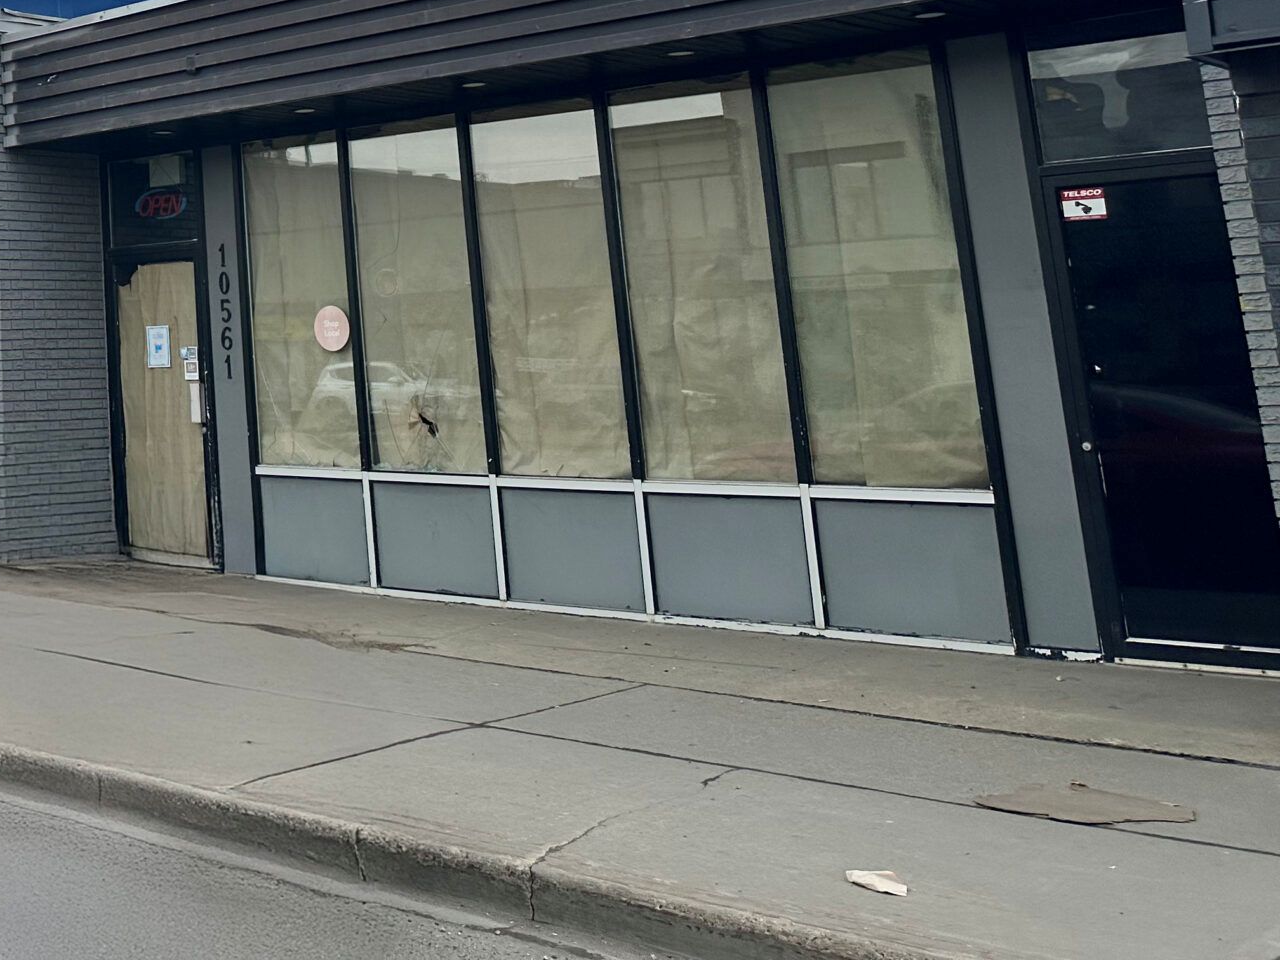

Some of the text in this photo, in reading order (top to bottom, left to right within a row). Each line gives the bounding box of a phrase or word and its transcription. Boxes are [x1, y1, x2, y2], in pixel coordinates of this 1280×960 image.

[1063, 189, 1102, 197] TELSCO
[140, 194, 182, 217] OPEN
[218, 243, 233, 380] 10561
